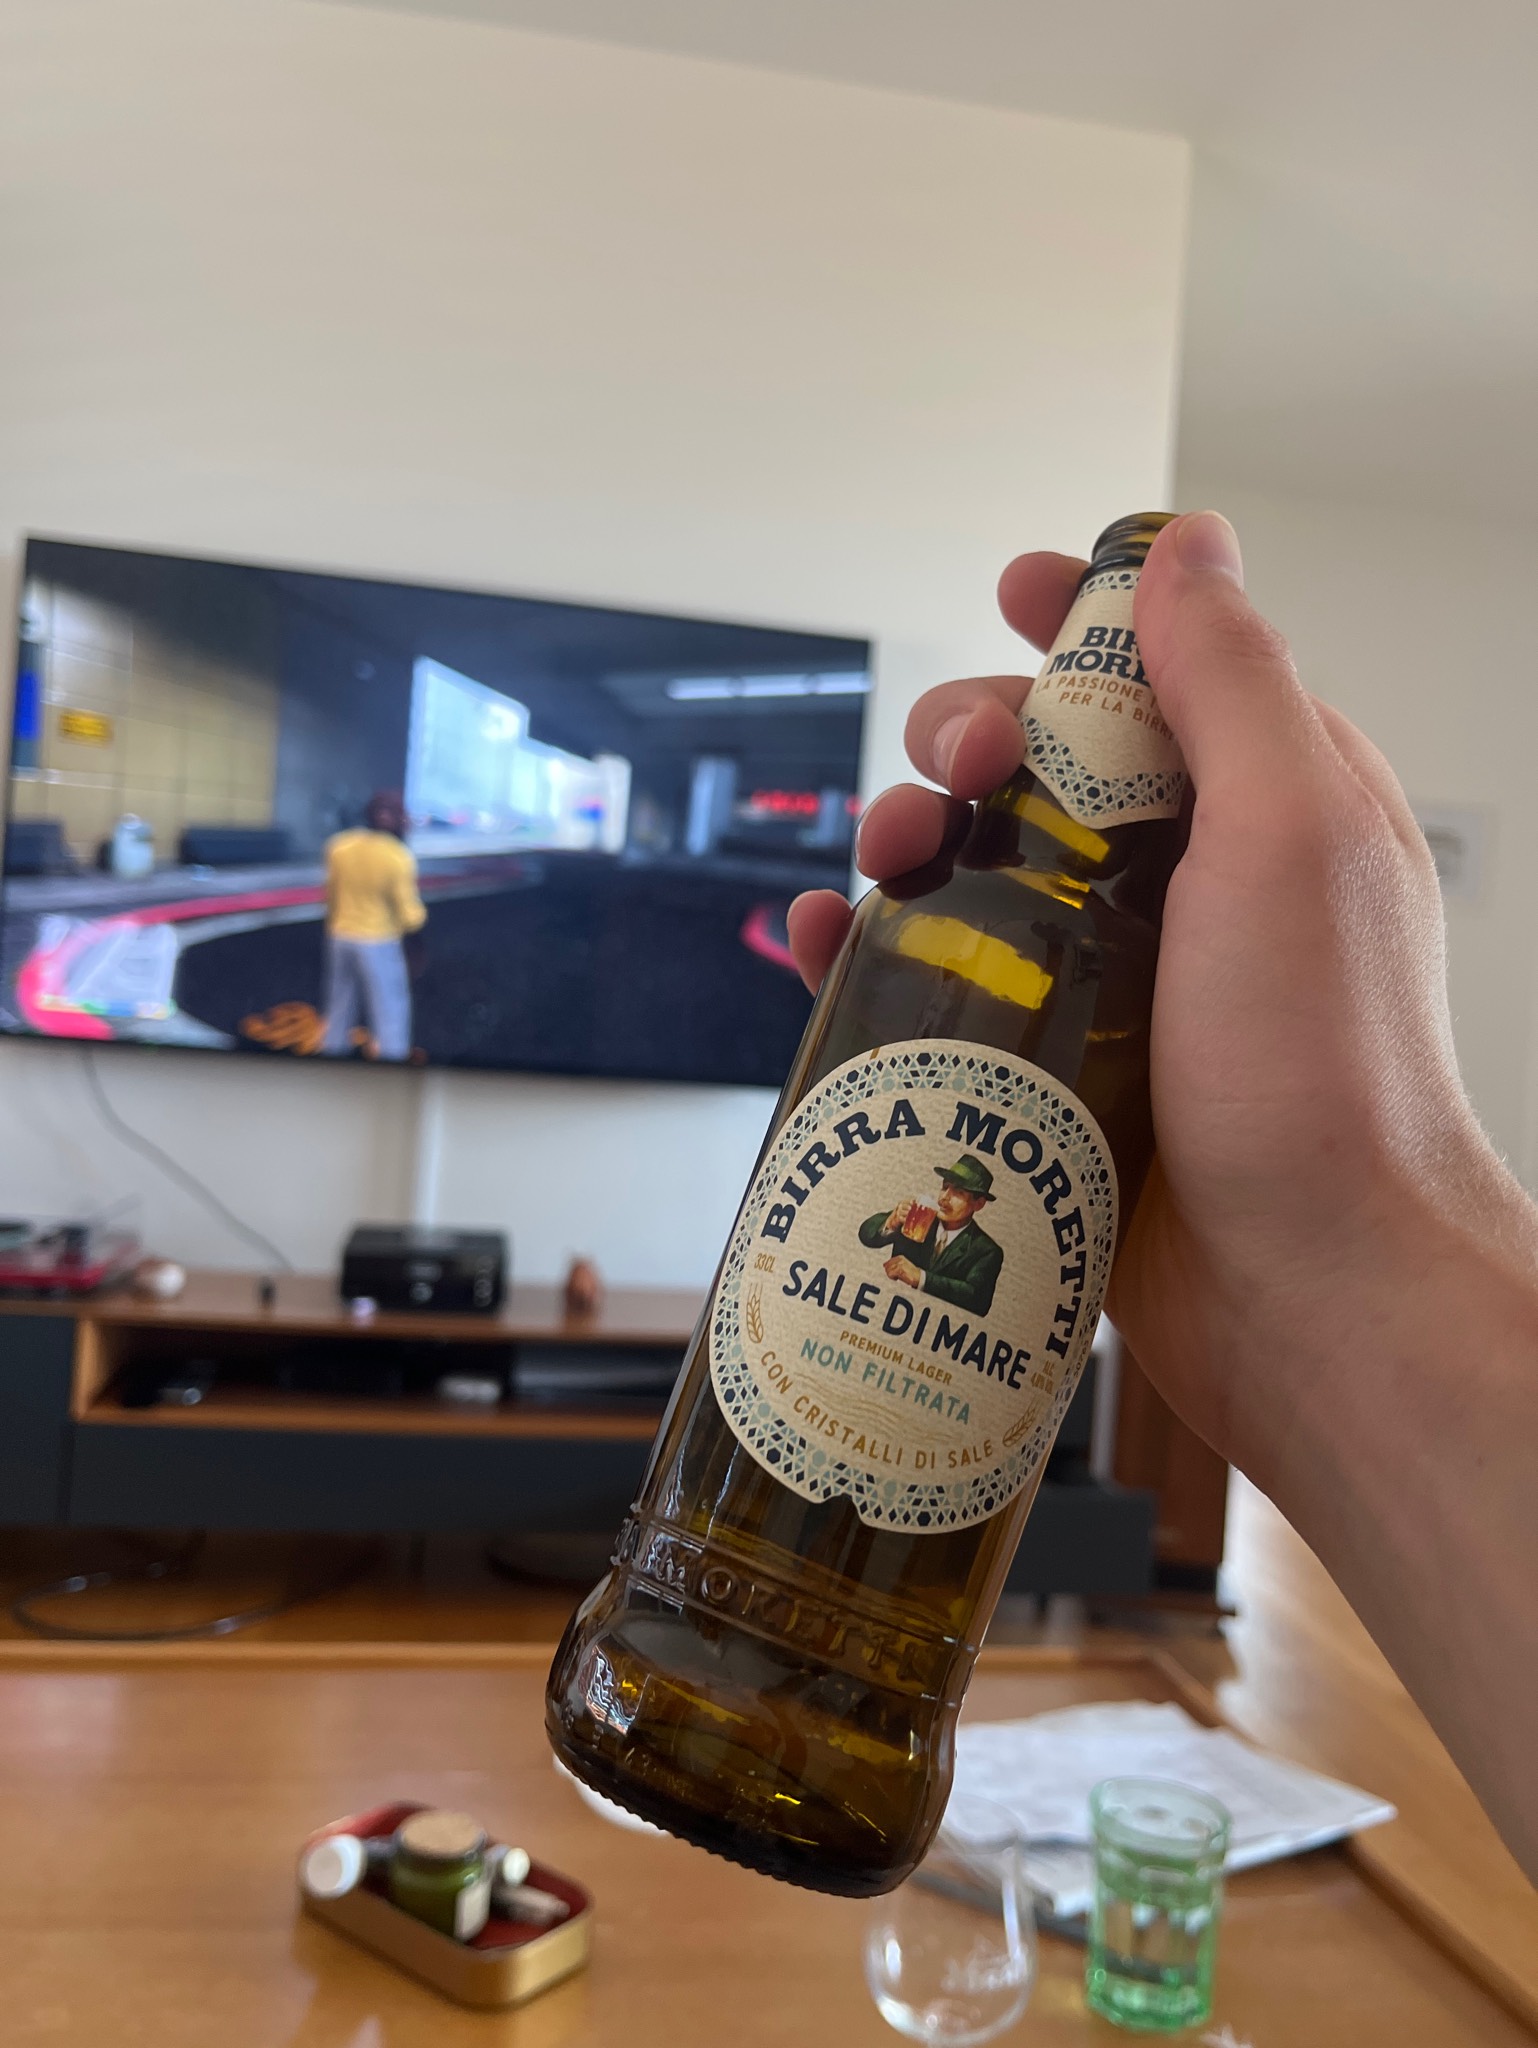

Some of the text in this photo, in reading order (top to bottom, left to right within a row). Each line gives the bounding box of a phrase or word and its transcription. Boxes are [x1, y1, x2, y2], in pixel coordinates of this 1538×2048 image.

[1080, 626, 1141, 656] BIR
[1057, 676, 1144, 702] PASSIONE
[1059, 691, 1093, 706] PER
[1101, 697, 1123, 714] LA
[760, 1098, 926, 1243] BIRRA
[754, 1252, 776, 1273] 33CL
[945, 1101, 1087, 1360] MORETTI
[782, 1260, 1031, 1390] SALE DI MARE
[840, 1330, 953, 1386] PREMIUM LAGER
[761, 1351, 993, 1470] CON CRISTALLI DI SALE
[800, 1338, 970, 1425] NON FILTRATA
